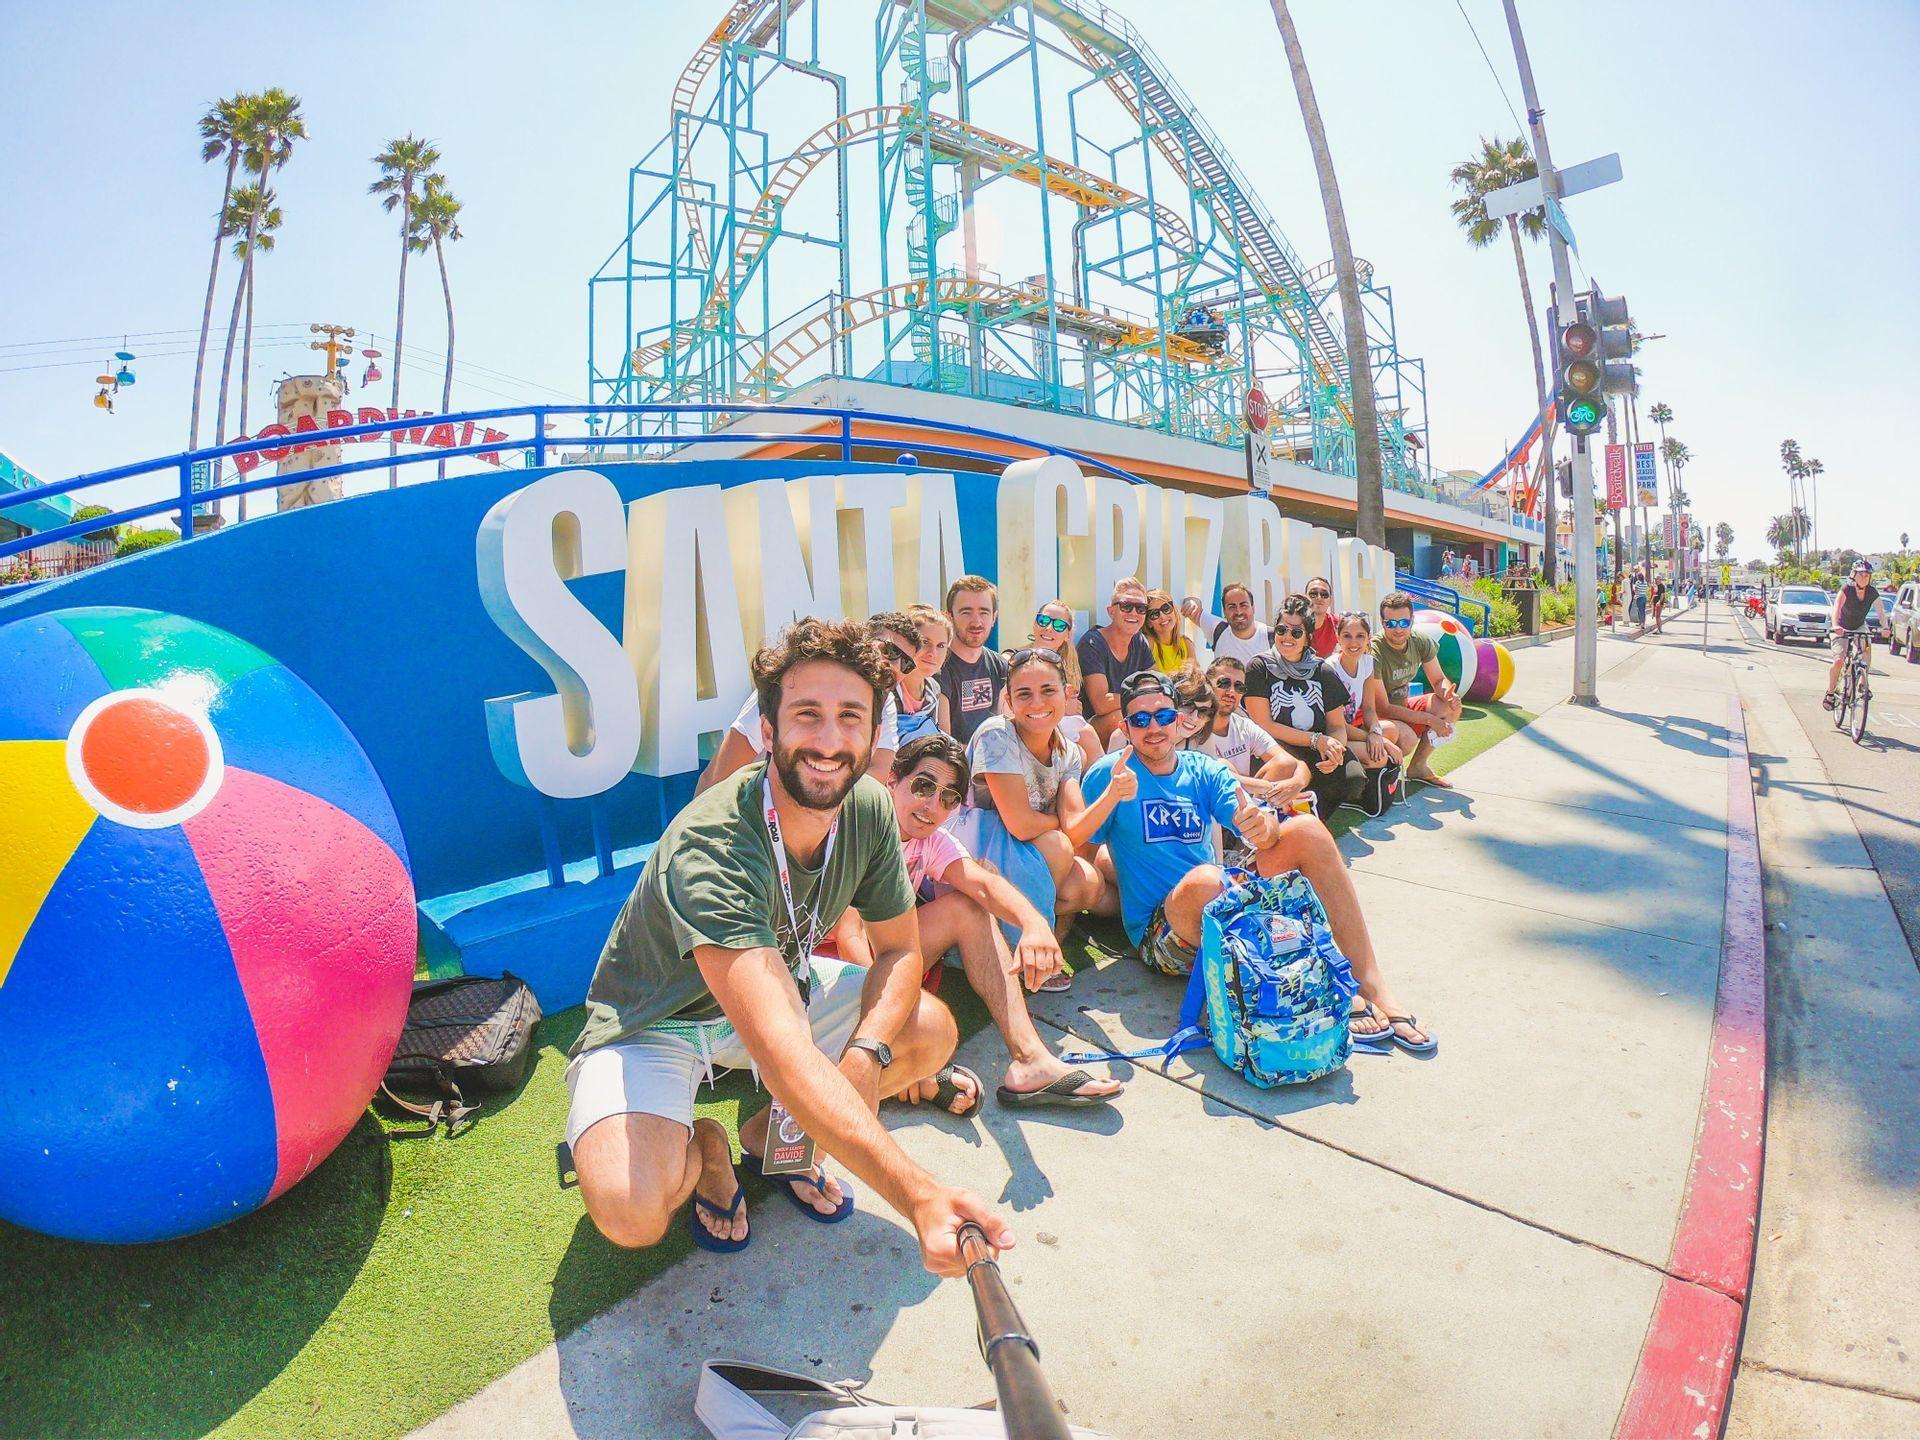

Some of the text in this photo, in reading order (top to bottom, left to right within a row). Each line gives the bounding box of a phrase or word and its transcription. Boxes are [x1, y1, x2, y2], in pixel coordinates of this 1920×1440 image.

[1249, 399, 1267, 420] STOP
[1609, 447, 1623, 503] Boardwalk
[1636, 460, 1654, 468] BEST
[1637, 481, 1657, 489] PARK
[476, 470, 966, 799] SANTA
[766, 808, 780, 843] WEROAD
[1148, 804, 1201, 828] CRETE
[774, 1151, 804, 1160] DAVIDE
